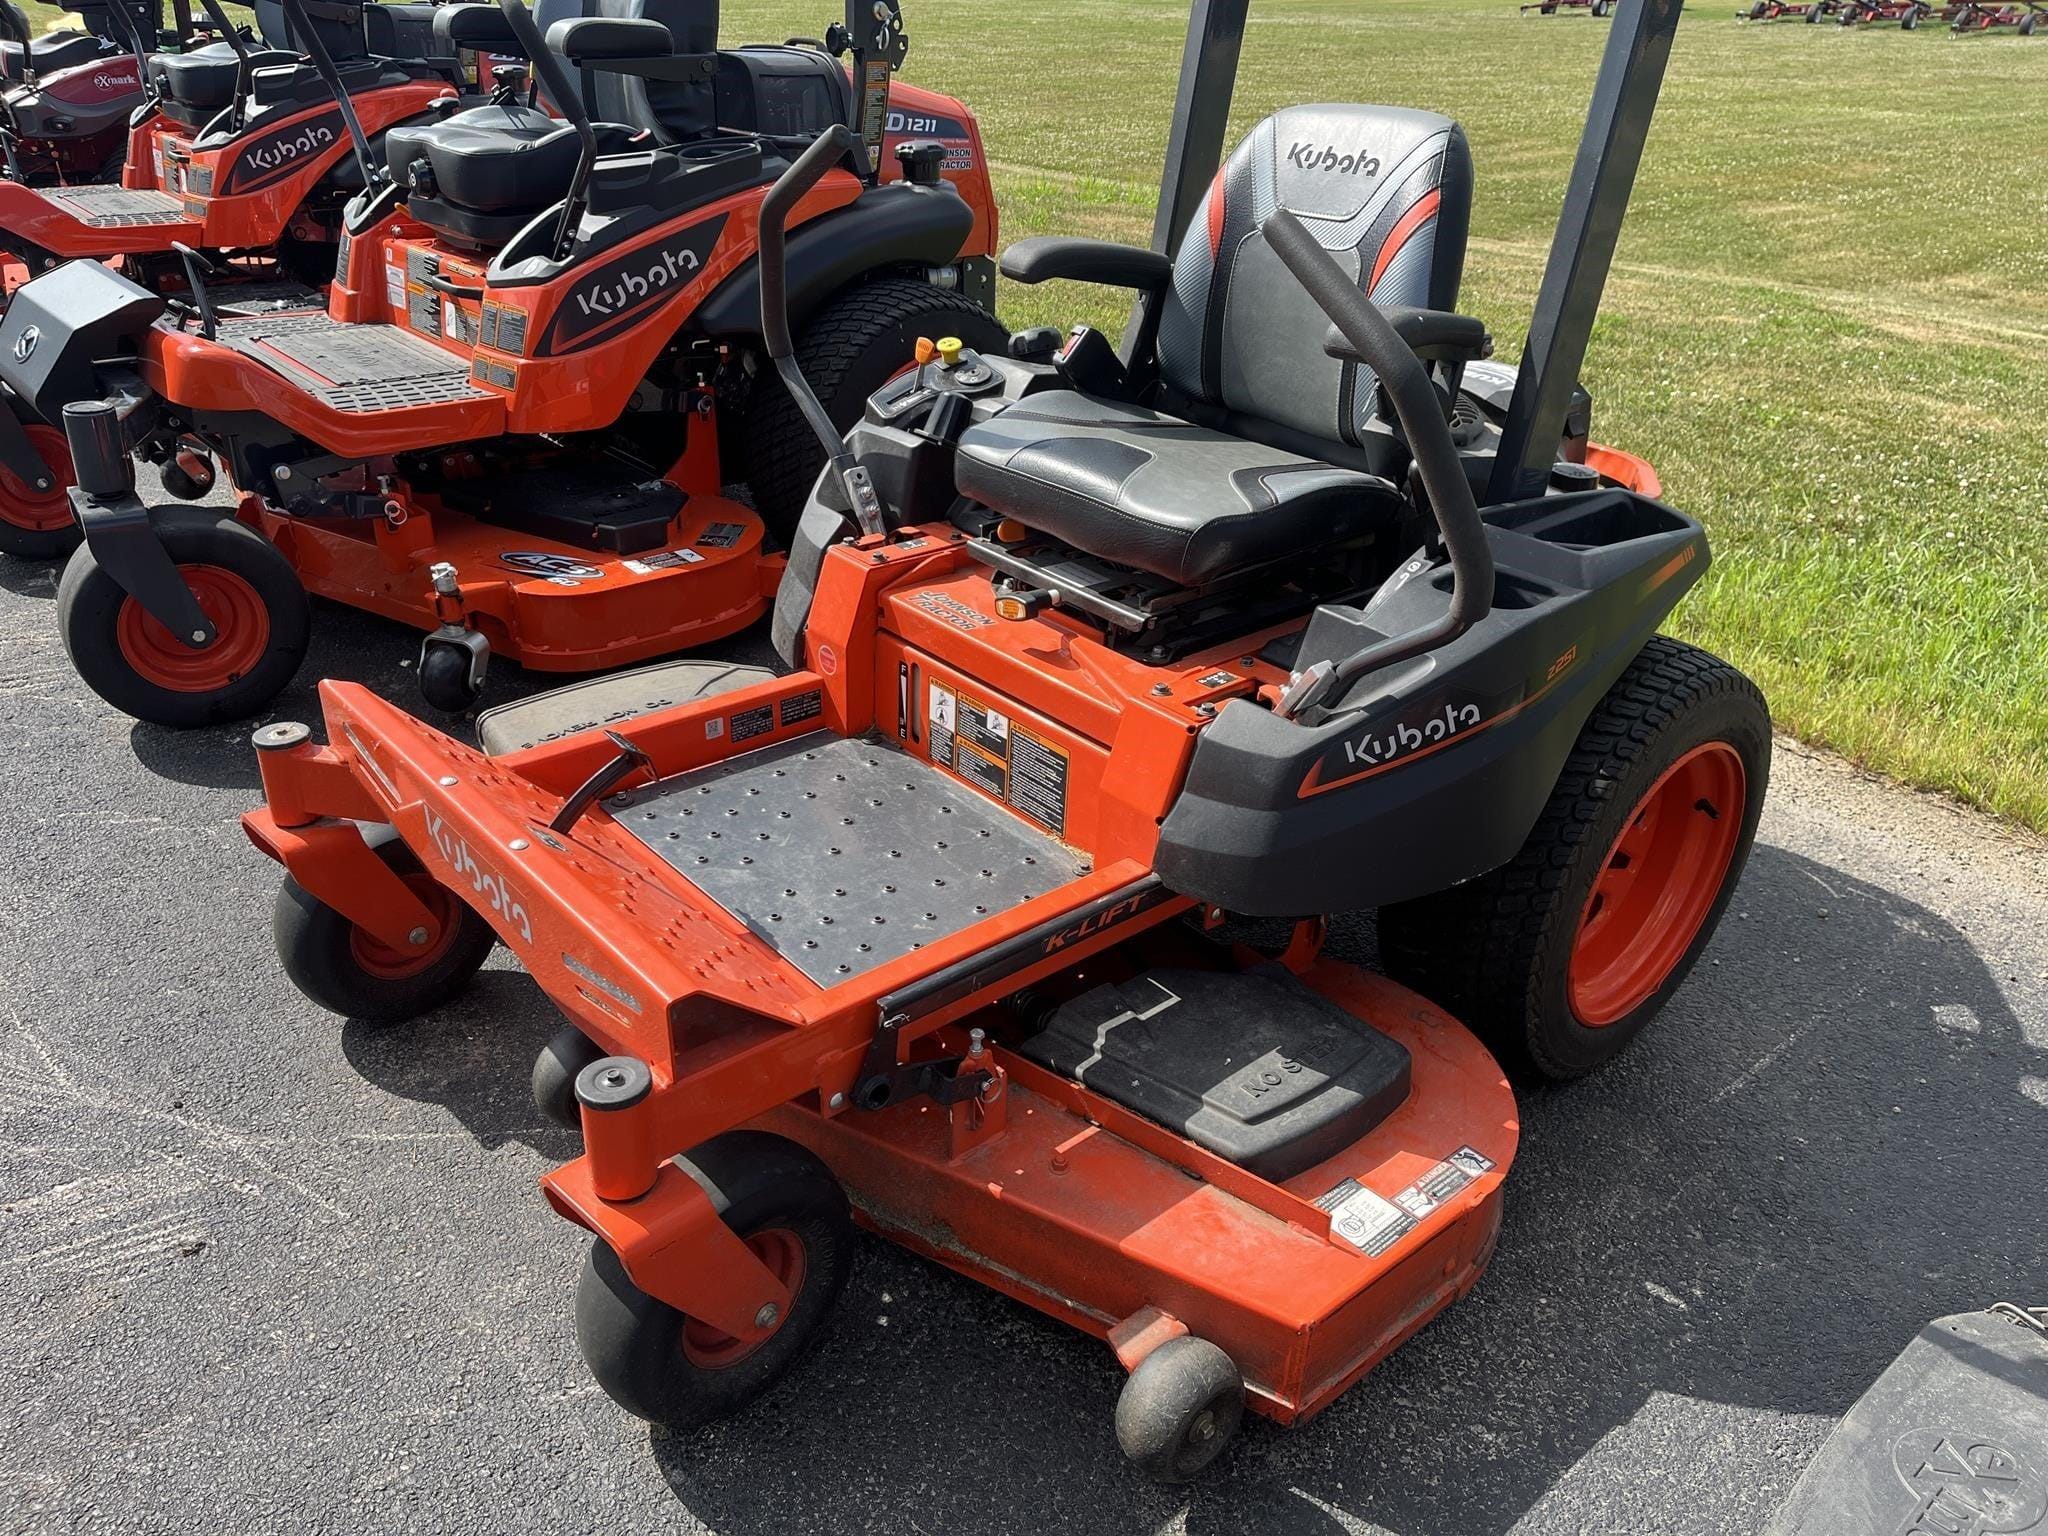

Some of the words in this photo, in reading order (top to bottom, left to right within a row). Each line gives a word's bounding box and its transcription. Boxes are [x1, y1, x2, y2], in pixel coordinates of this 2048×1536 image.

[907, 117, 937, 133] 1211
[246, 126, 334, 170] Kubota
[938, 160, 972, 170] RACTOR
[1287, 141, 1382, 179] Kubota
[576, 248, 701, 316] Kubota
[909, 596, 978, 631] TRACTOR
[920, 589, 997, 627] JOHNSON
[934, 679, 955, 696] WARNING
[963, 695, 987, 712] WARNING
[962, 739, 985, 757] WARNING
[1016, 725, 1041, 742] WARNING
[1343, 702, 1481, 765] Kubota
[423, 803, 534, 945] Kubota
[1044, 892, 1148, 952] K-LIFT
